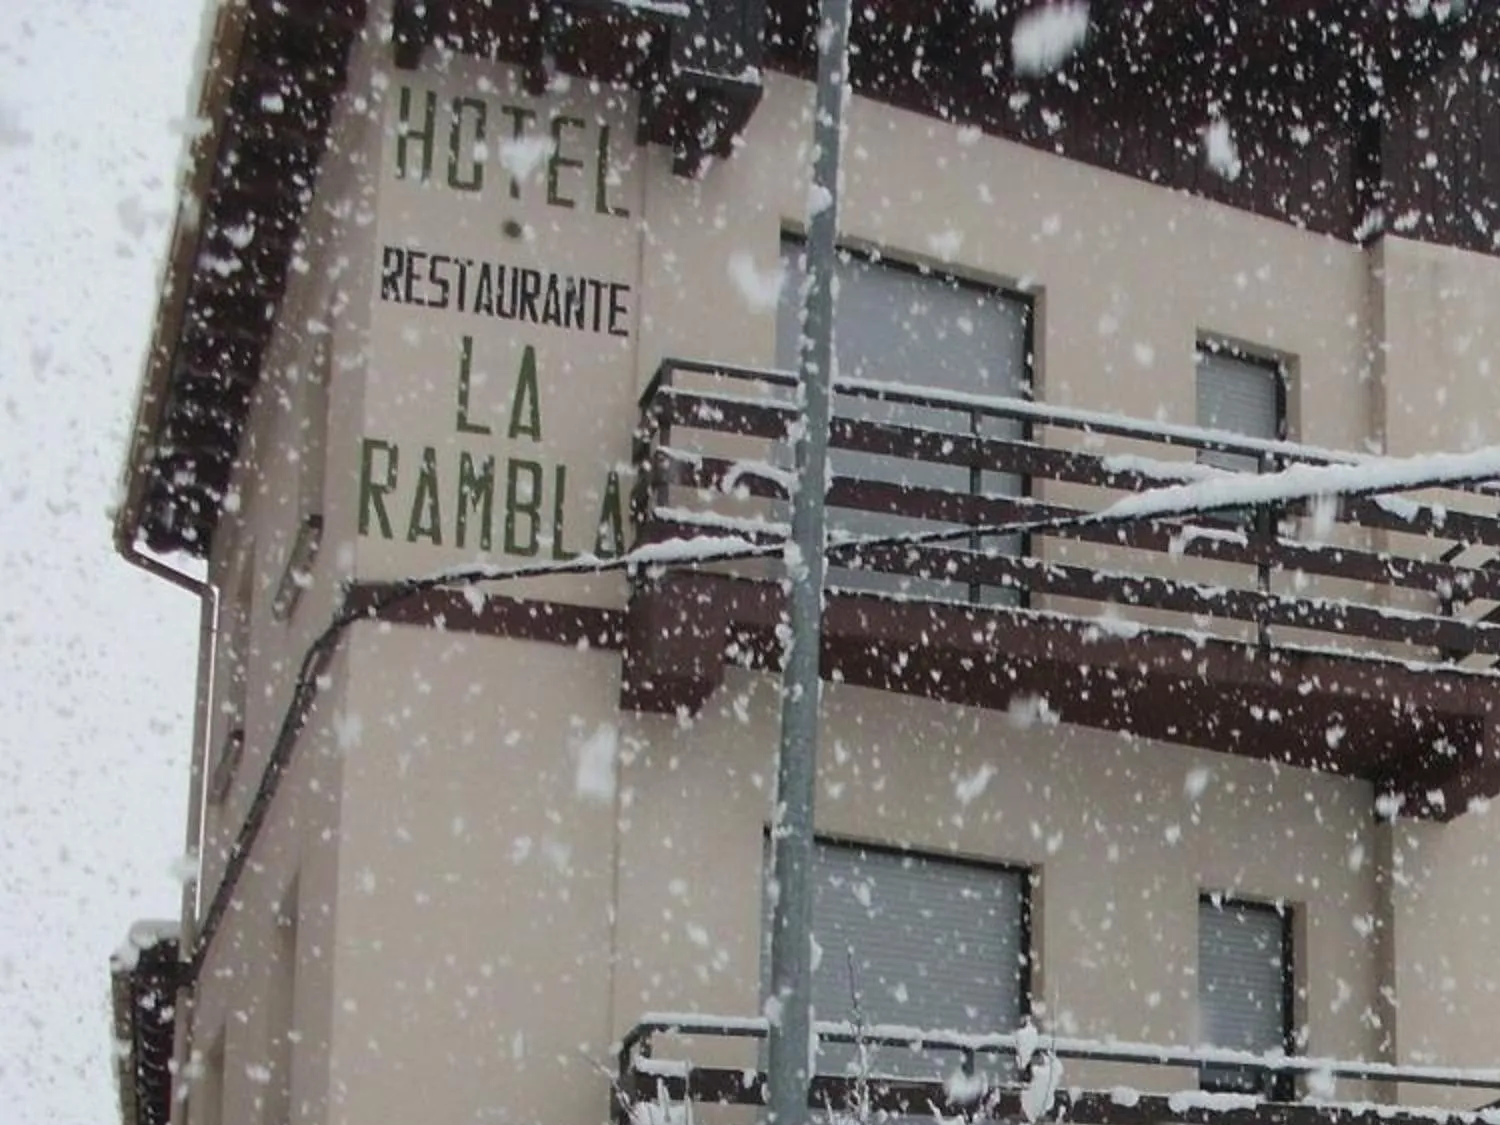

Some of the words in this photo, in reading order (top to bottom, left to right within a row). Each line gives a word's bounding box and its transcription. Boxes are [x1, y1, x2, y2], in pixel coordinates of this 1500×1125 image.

[396, 86, 630, 219] HOTEL
[380, 245, 631, 337] RESTAURANTE
[457, 336, 542, 442] LA
[358, 438, 625, 560] RAMBLA
